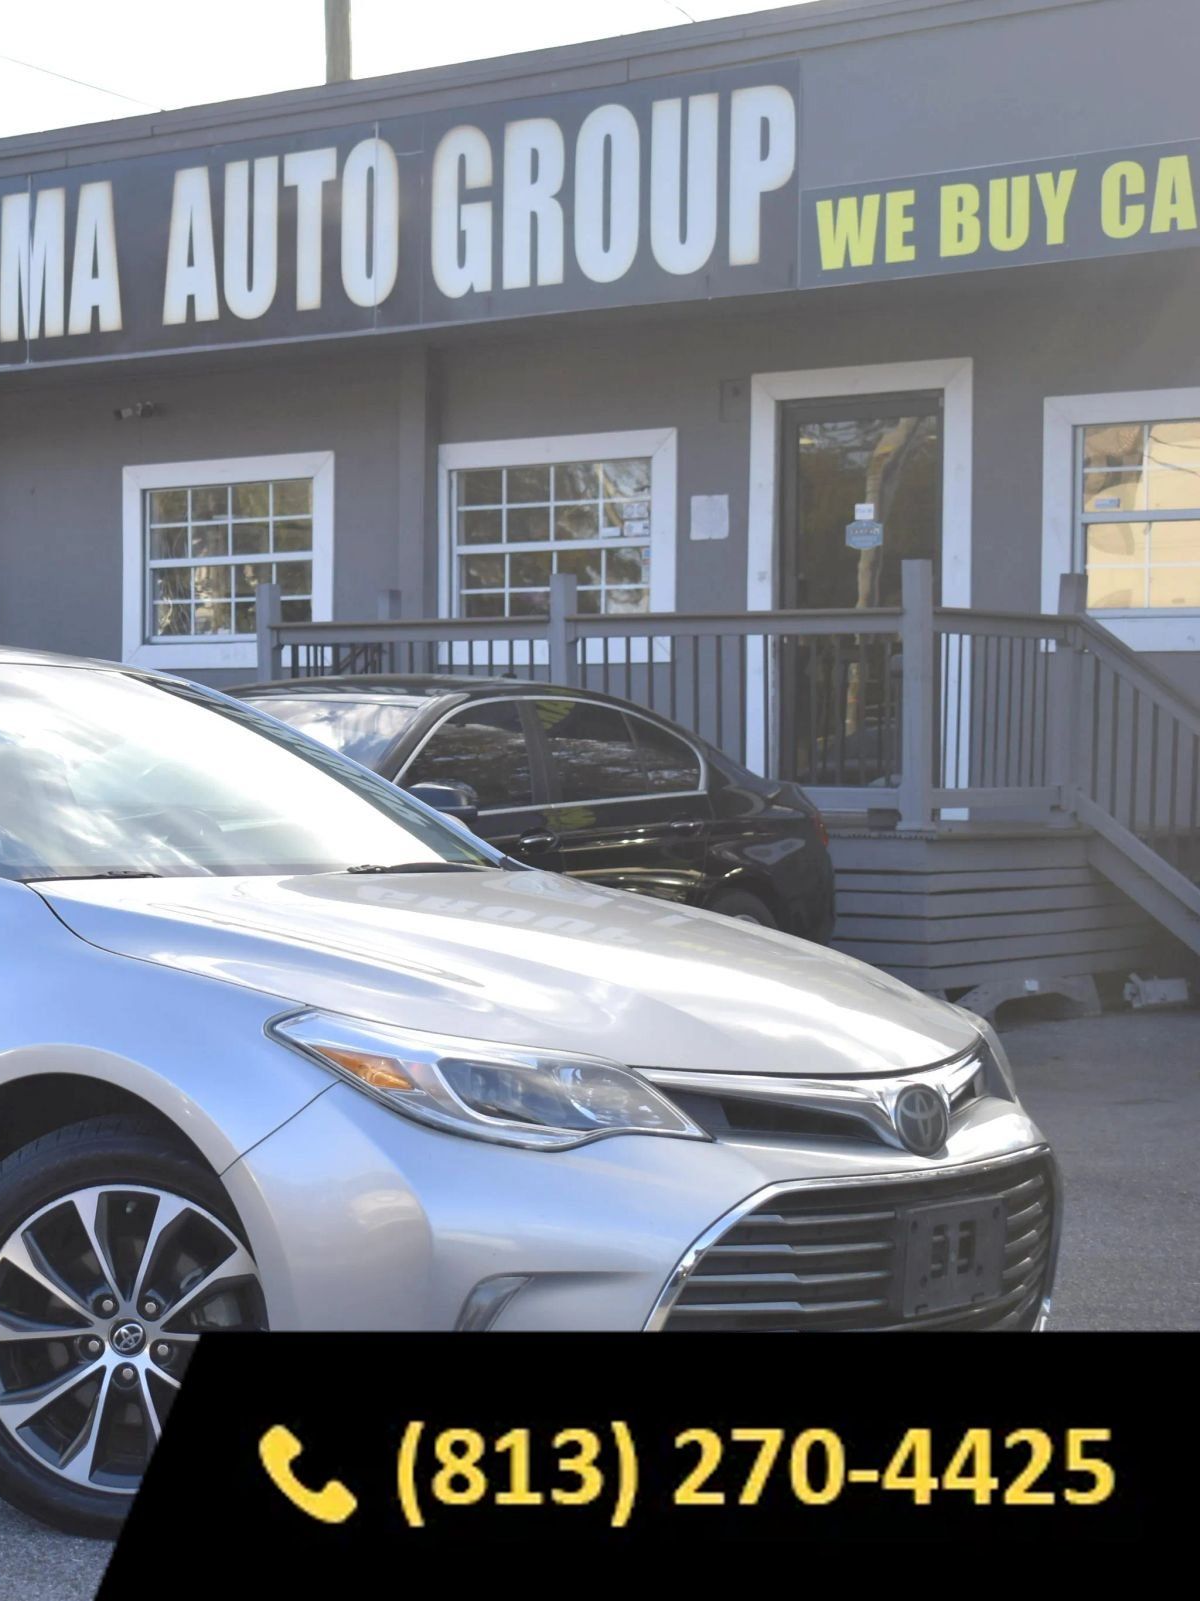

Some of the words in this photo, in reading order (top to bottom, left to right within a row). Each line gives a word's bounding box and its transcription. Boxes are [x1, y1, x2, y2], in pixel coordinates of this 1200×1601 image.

[163, 138, 399, 325] AUTO
[431, 84, 796, 298] GROUP
[816, 190, 915, 270] WE
[940, 169, 1077, 257] BUY
[1100, 155, 1198, 239] CA
